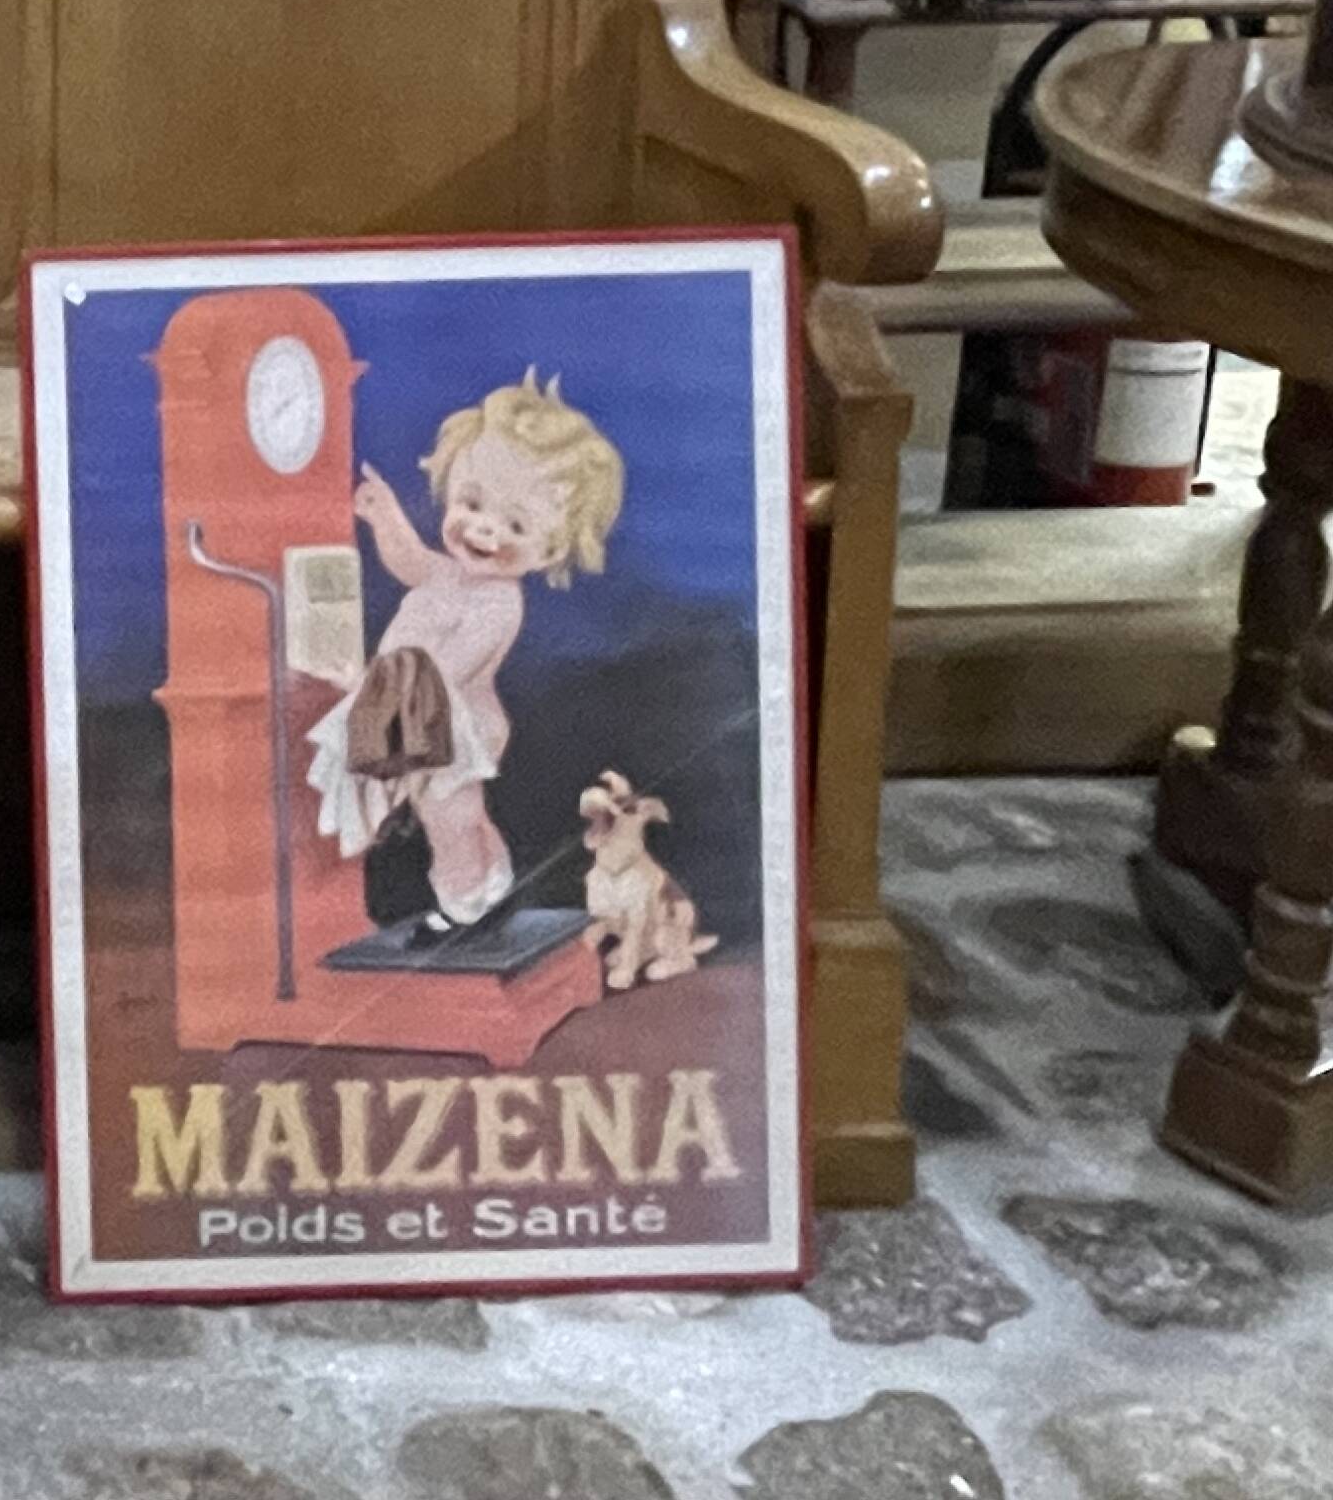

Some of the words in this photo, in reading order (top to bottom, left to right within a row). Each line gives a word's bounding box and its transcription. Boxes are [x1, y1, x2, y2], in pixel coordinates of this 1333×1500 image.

[129, 1067, 741, 1200] MAIZENA
[197, 1203, 366, 1248] Poids
[386, 1202, 449, 1241] et
[472, 1193, 668, 1239] Santé
